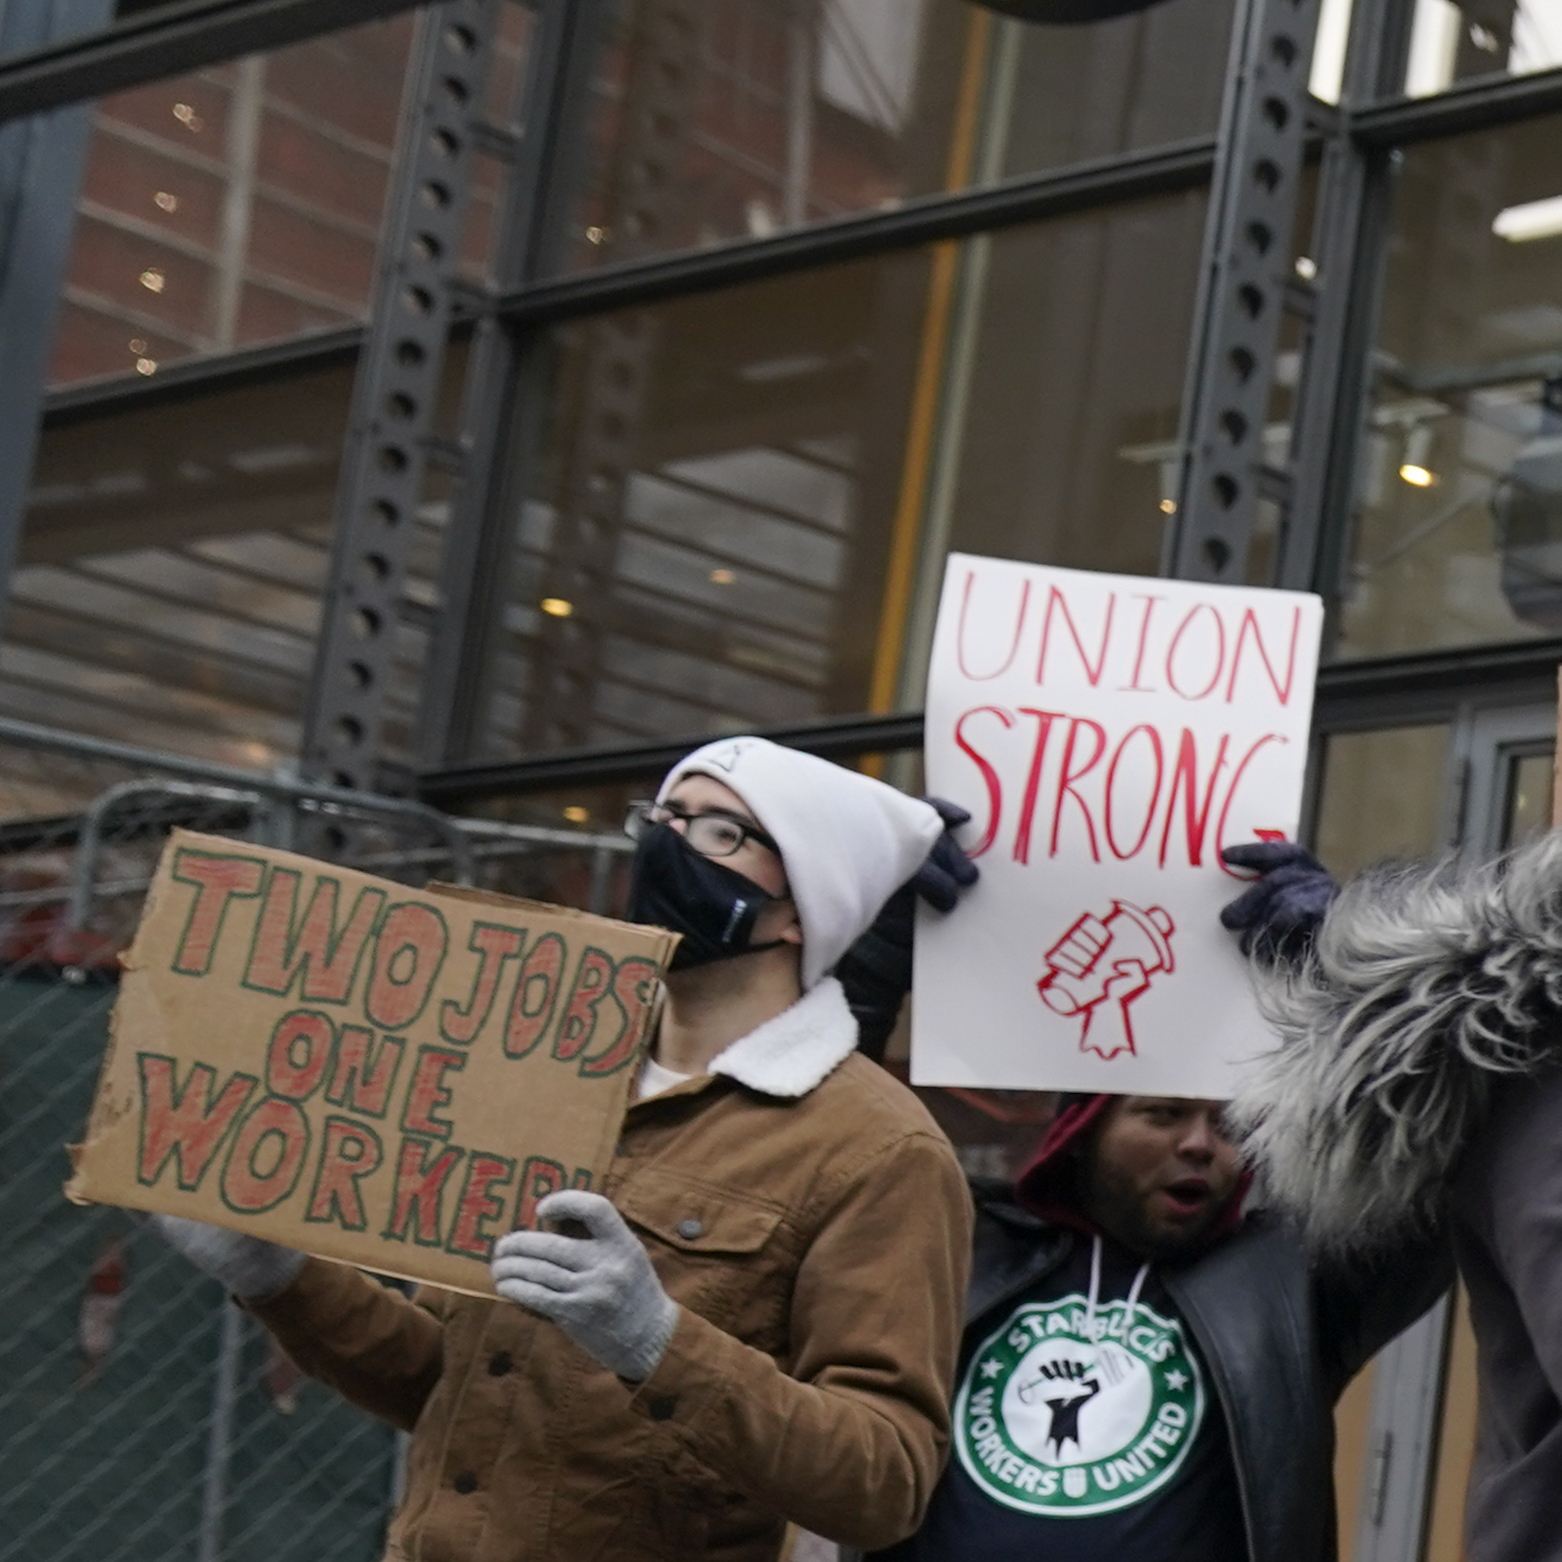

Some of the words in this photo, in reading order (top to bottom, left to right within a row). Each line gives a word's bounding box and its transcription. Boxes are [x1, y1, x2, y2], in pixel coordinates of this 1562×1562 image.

[957, 571, 1302, 706] UNION
[955, 705, 1289, 881] STRONG
[171, 847, 450, 1031] TWO
[440, 920, 658, 1078] JOBS
[265, 1009, 470, 1141] ONE
[137, 1052, 593, 1262] WORKER
[970, 1386, 1058, 1496] WORKERS
[1092, 1401, 1188, 1491] UNITED
